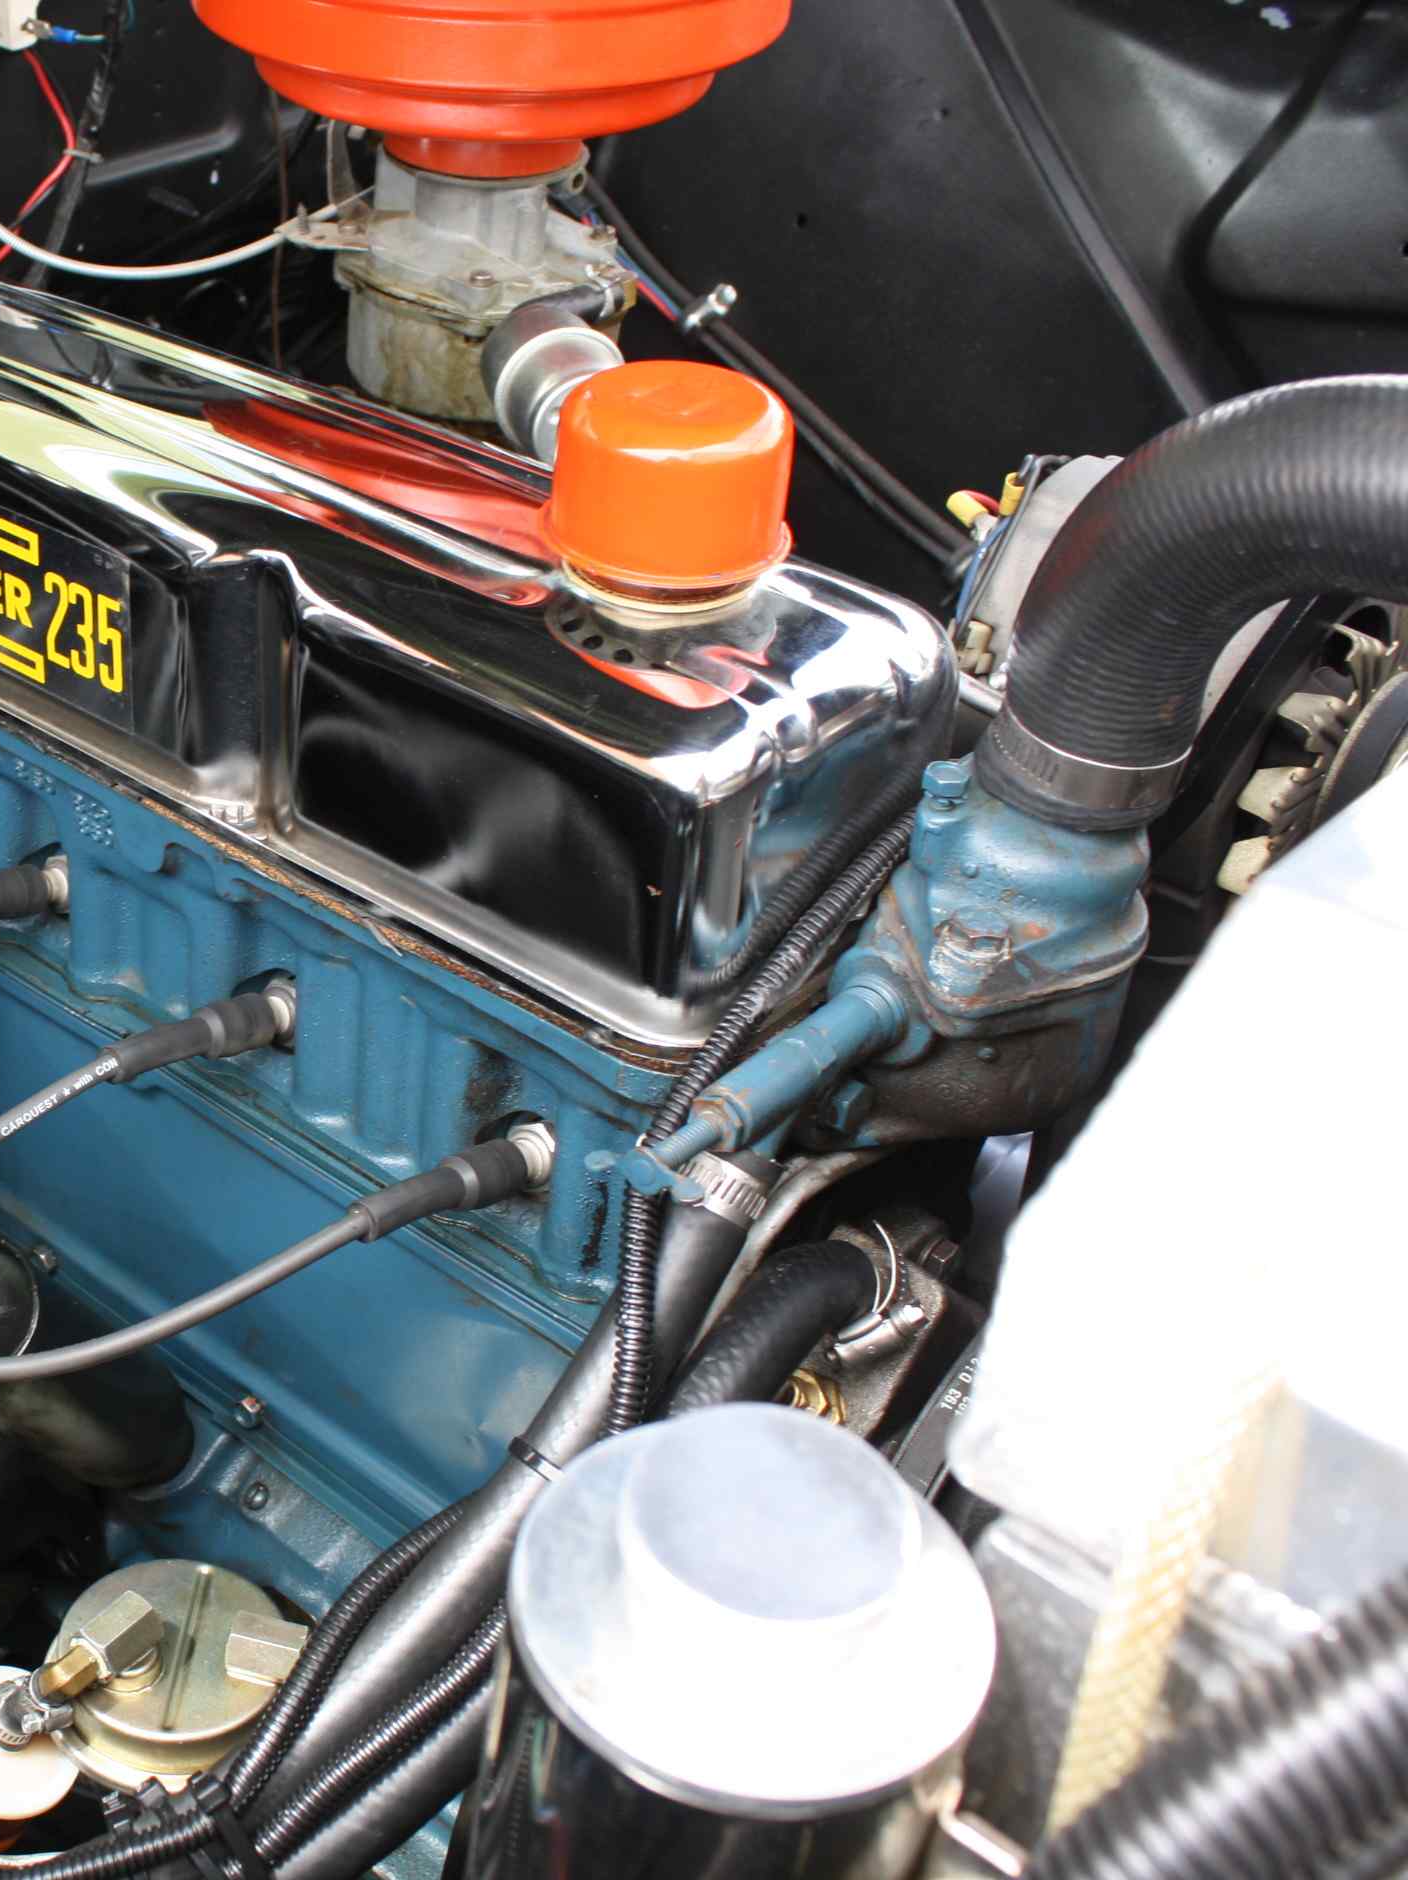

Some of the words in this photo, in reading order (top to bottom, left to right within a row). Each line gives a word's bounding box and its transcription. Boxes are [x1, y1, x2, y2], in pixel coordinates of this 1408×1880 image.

[43, 570, 124, 694] 235
[0, 1094, 60, 1137] CARQUEST
[73, 1072, 94, 1090] with
[95, 1057, 119, 1077] CON
